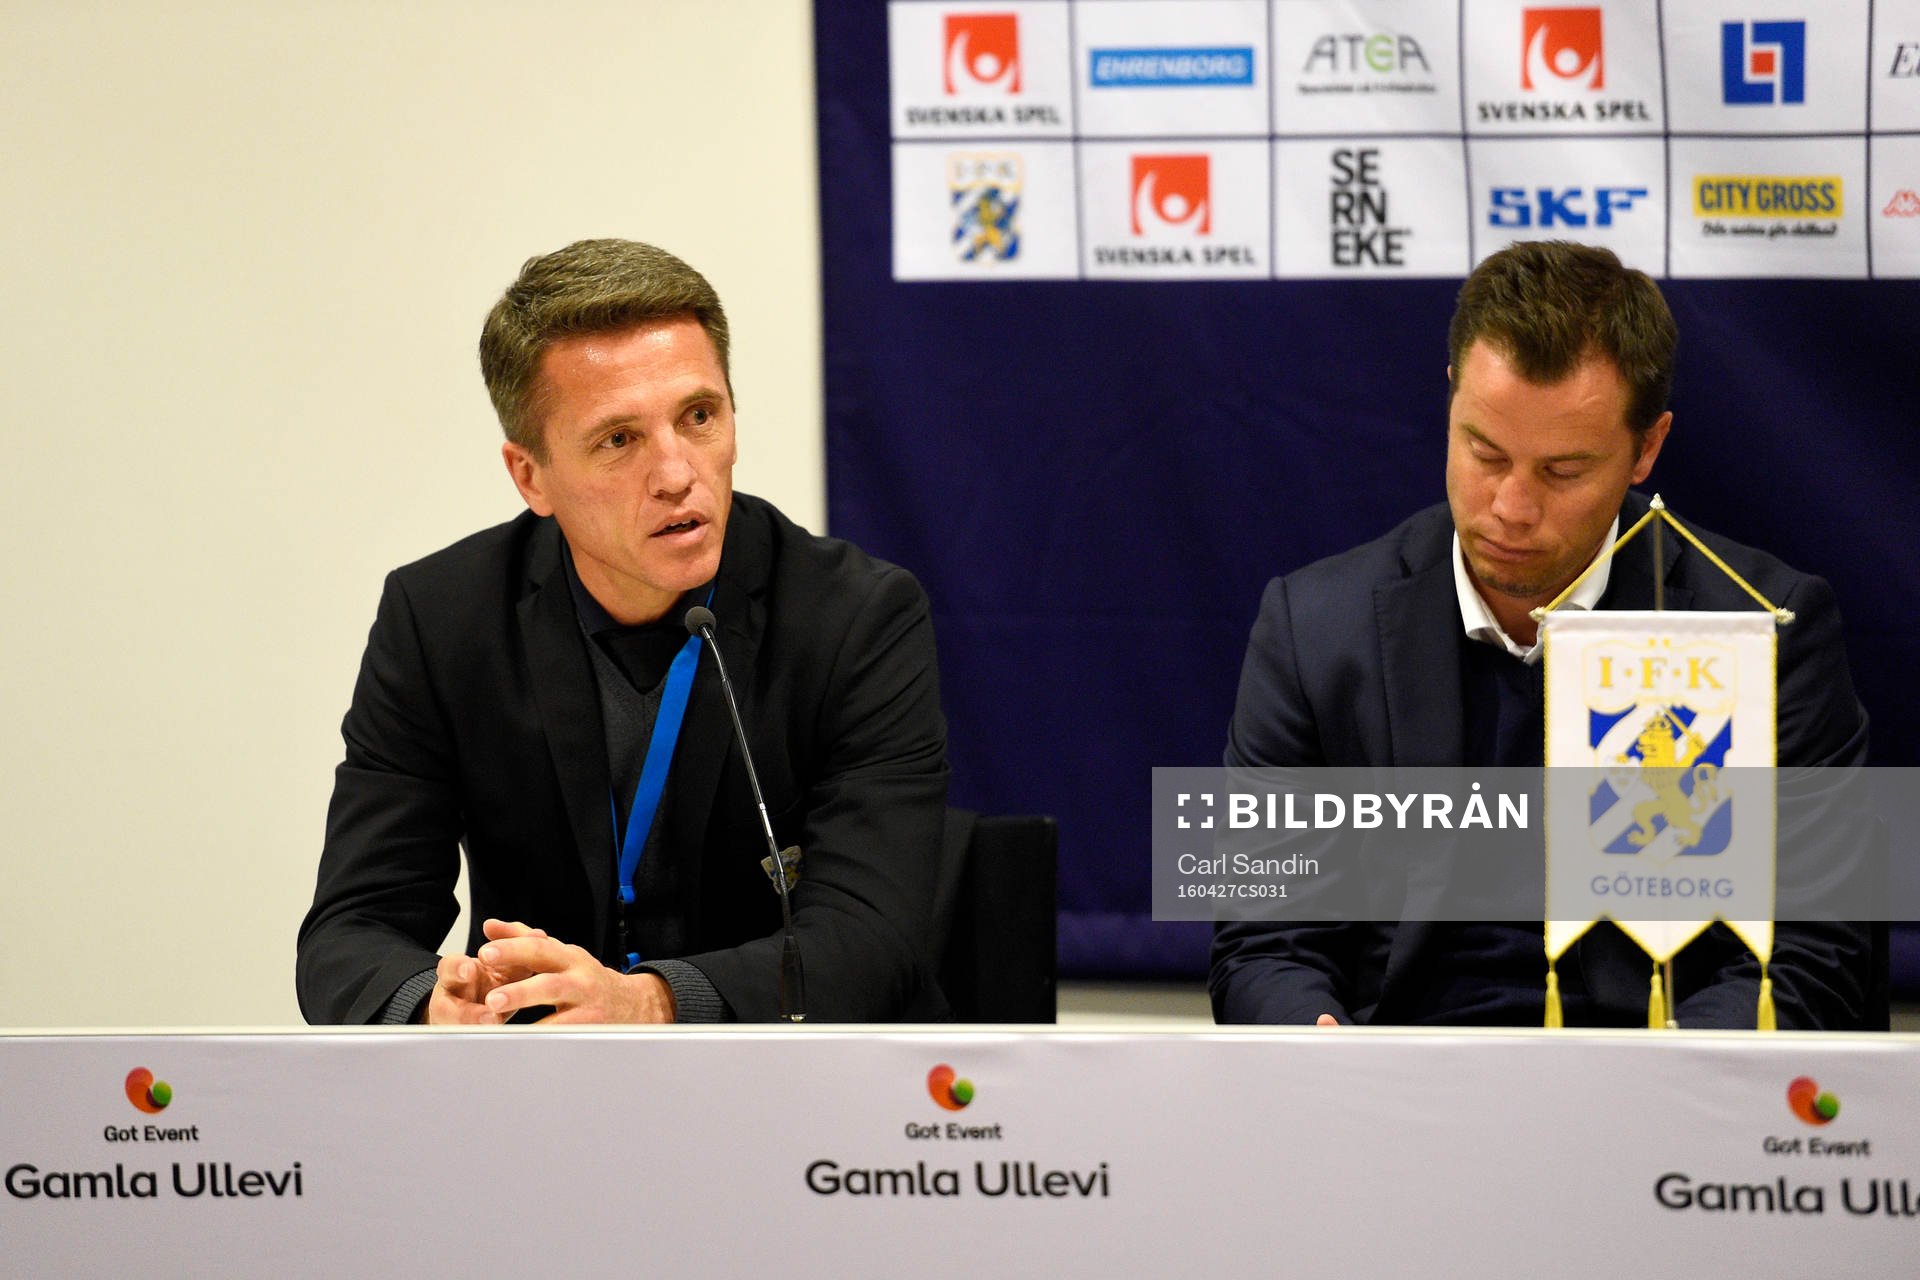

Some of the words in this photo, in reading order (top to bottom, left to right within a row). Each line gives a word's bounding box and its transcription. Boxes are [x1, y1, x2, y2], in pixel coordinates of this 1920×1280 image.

[1304, 34, 1432, 72] ATEA
[1097, 55, 1249, 80] EHRENBORG
[906, 107, 1005, 126] SVENSKA
[1015, 106, 1061, 125] SPEL
[1478, 102, 1588, 122] SVENSKA
[1595, 101, 1650, 121] SPEL
[1488, 188, 1648, 228] SKF
[1699, 181, 1750, 211] CITY
[1756, 182, 1837, 212] GROSS
[1094, 247, 1194, 266] SVENSKA
[1203, 246, 1255, 265] SPEL
[1590, 871, 1735, 899] GÖTEBORG
[103, 1125, 139, 1142] Got
[144, 1125, 199, 1142] Event
[905, 1123, 940, 1140] Got
[946, 1123, 1002, 1140] Event
[1763, 1136, 1801, 1154] Got
[1808, 1137, 1871, 1156] Event
[4, 1163, 158, 1199] Gamla
[172, 1162, 304, 1198] Ullevi
[804, 1160, 960, 1197] Gamla
[974, 1162, 1111, 1198] Ullevi
[1654, 1172, 1824, 1214] Gamla
[1840, 1177, 1920, 1218] Ull
